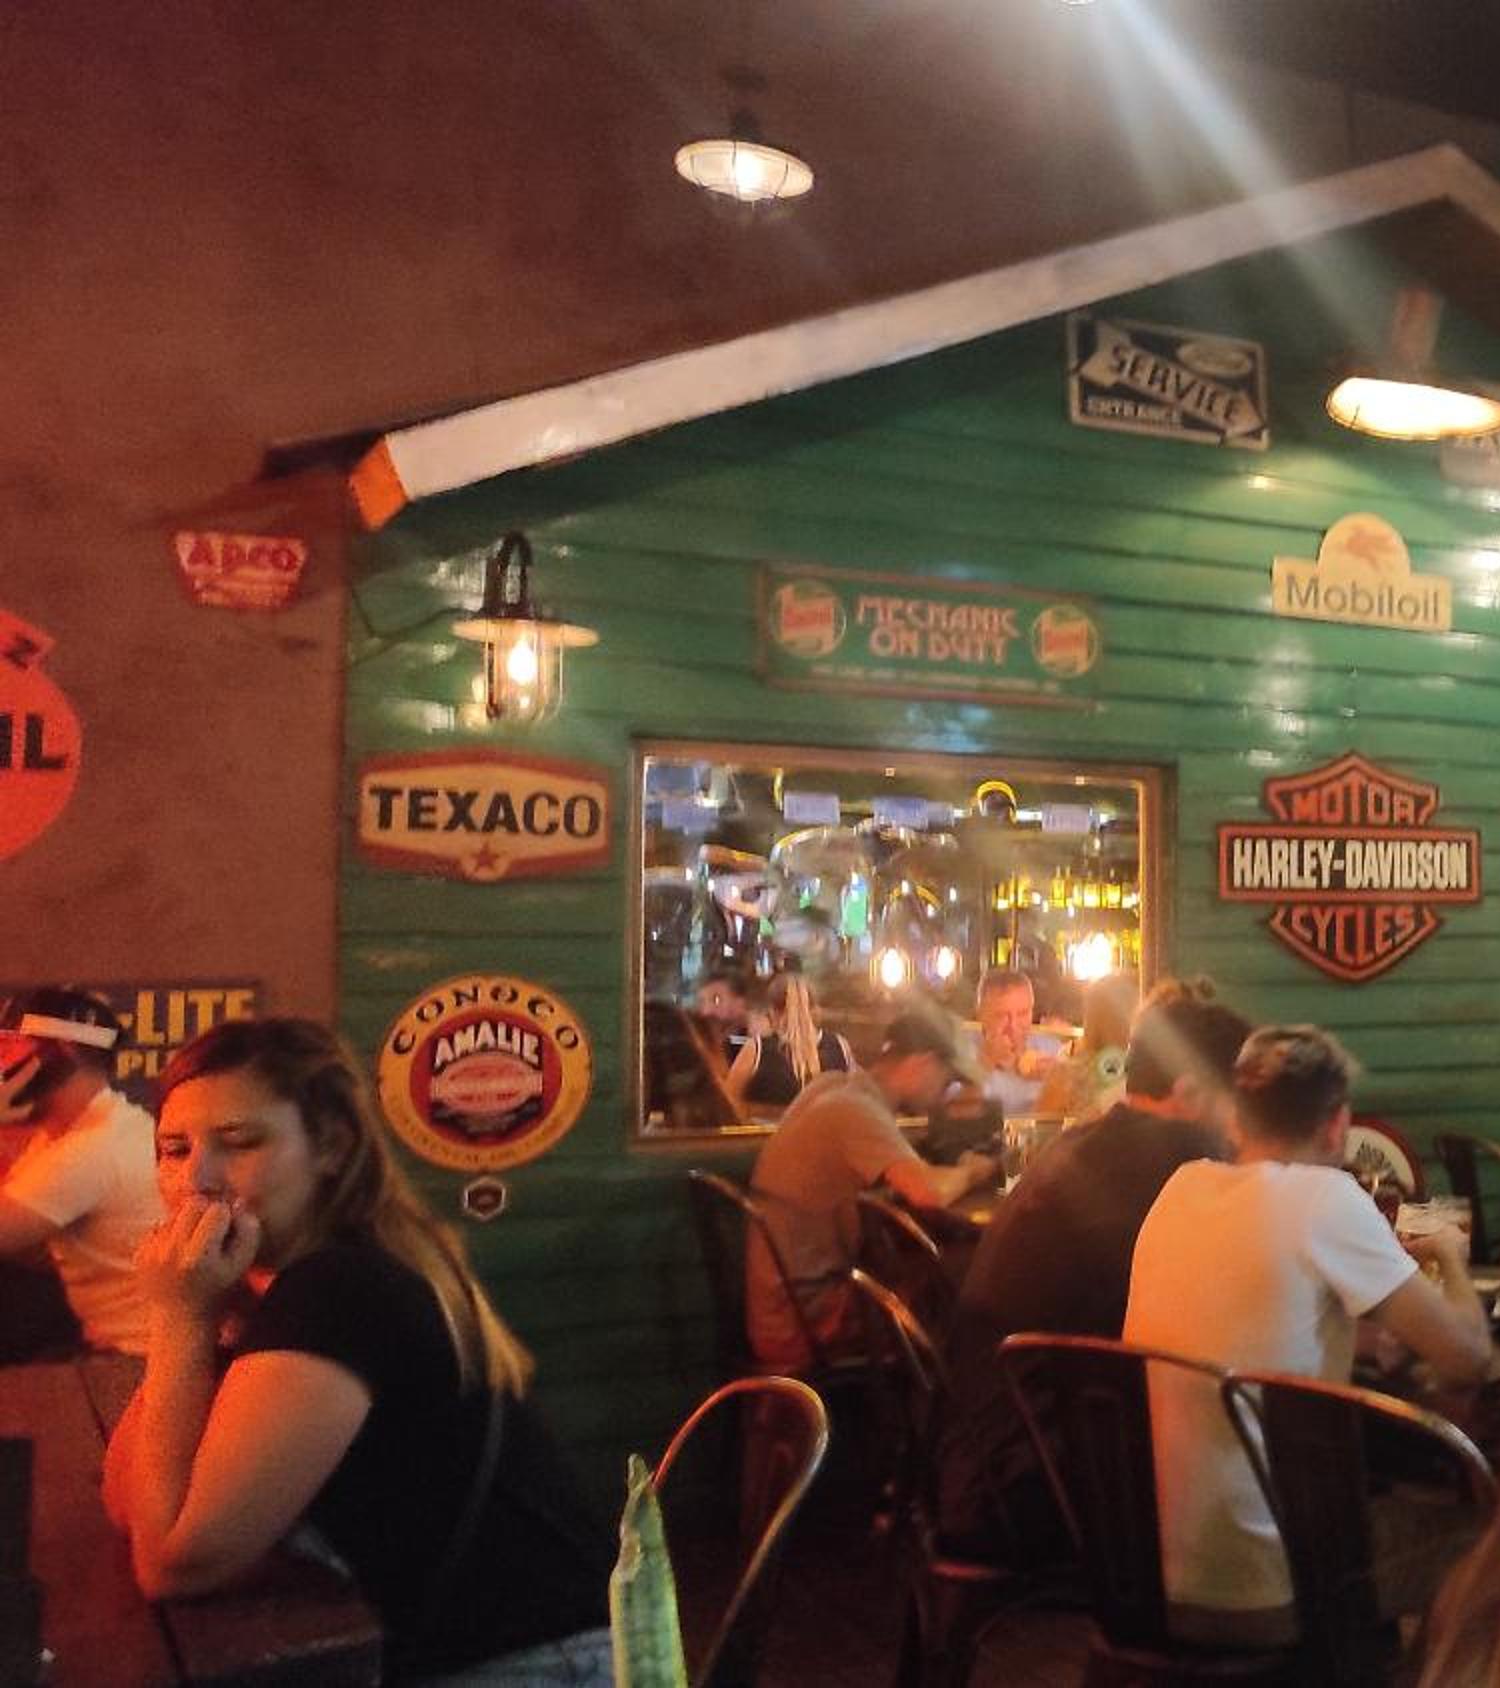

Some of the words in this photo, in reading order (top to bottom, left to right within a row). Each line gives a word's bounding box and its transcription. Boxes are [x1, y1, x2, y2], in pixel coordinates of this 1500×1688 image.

[1110, 345, 1238, 425] SERVICE
[1285, 574, 1439, 625] Mobiloil
[869, 626, 920, 657] ON
[928, 632, 1007, 665] DUTY
[369, 784, 602, 838] TEXACO
[1292, 772, 1416, 827] MOTOR
[1232, 837, 1468, 890] HARLEY-DAVIDSON
[1291, 902, 1417, 964] CYCLES
[393, 984, 579, 1056] CONOCO
[432, 1019, 541, 1068] AMALIE
